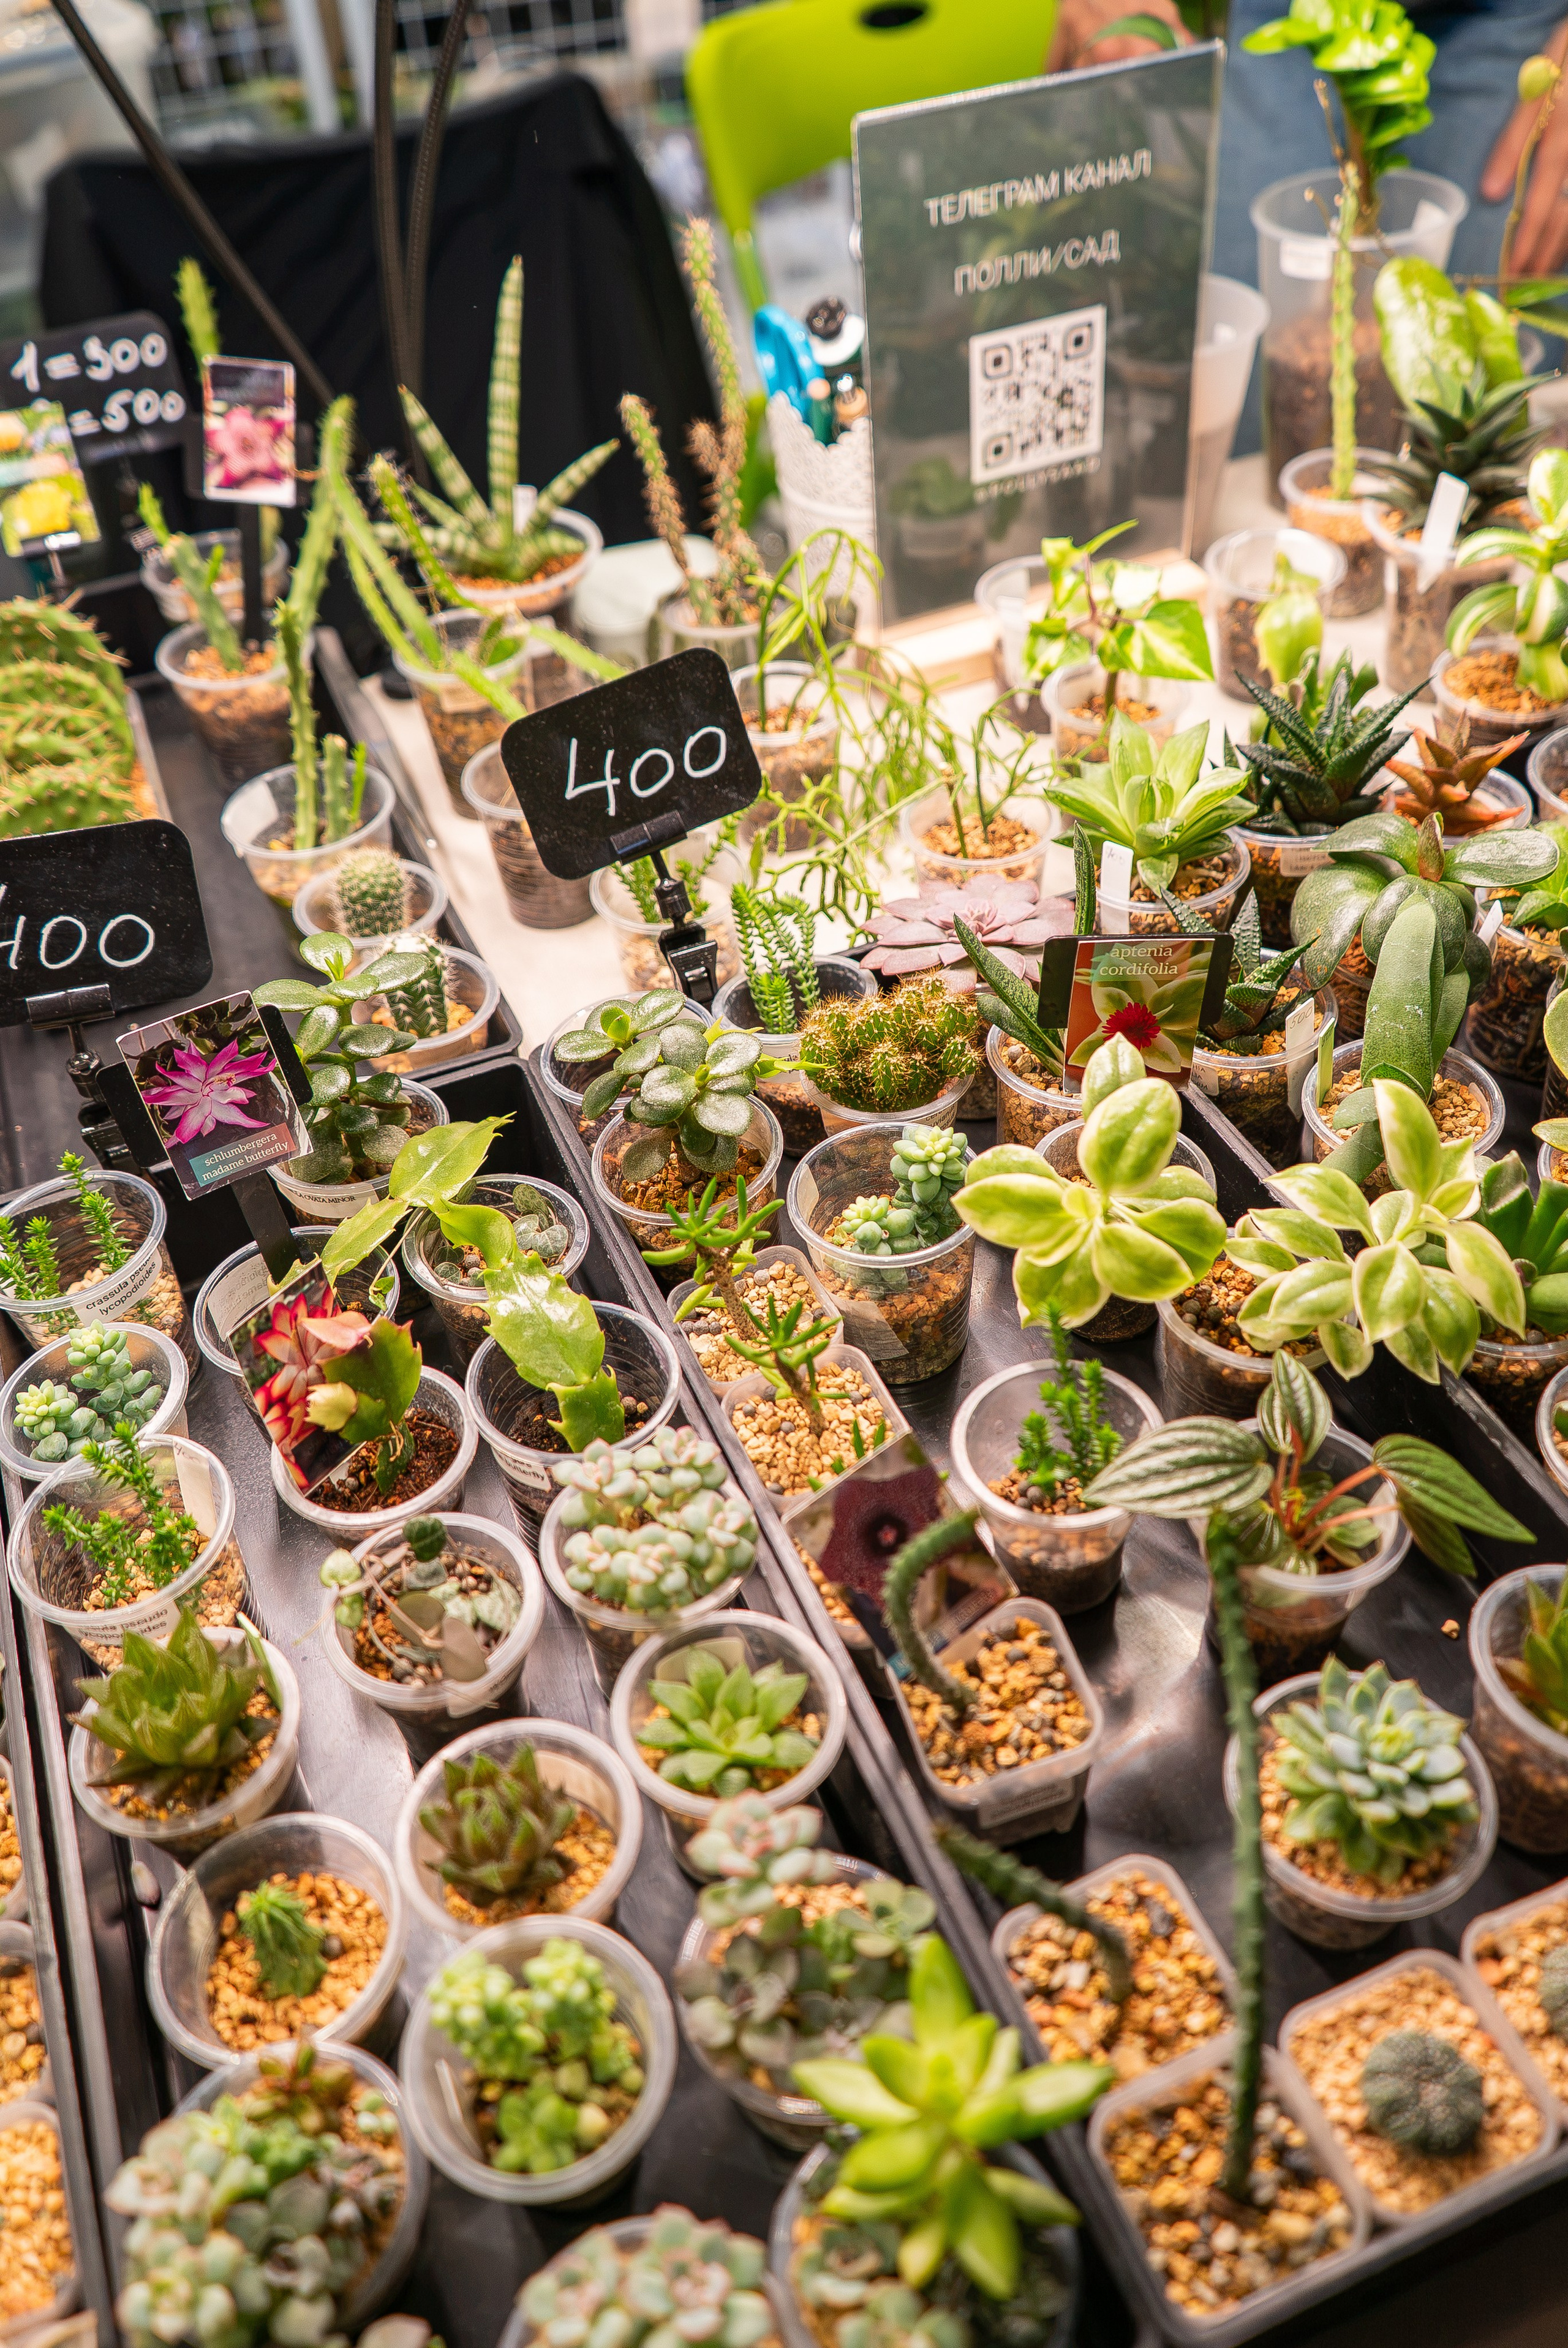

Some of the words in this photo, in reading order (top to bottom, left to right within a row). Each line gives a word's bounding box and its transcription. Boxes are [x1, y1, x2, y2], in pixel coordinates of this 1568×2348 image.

[923, 170, 1060, 228] ТЕЛЕГРАМ
[1065, 148, 1152, 196] КАНАЛ
[954, 229, 1121, 297] ПОЛЛИ/САД
[565, 725, 727, 817] 400
[1099, 962, 1178, 976] cordifolia
[1110, 945, 1173, 960] aptenia
[1289, 1006, 1313, 1029] 500
[202, 1158, 245, 1181] madame
[245, 1140, 288, 1164] butterfly
[204, 1133, 278, 1167] schlumbergera
[86, 1281, 129, 1310] crassula
[129, 1255, 151, 1283] pseu
[99, 1261, 157, 1316] lycopodioides
